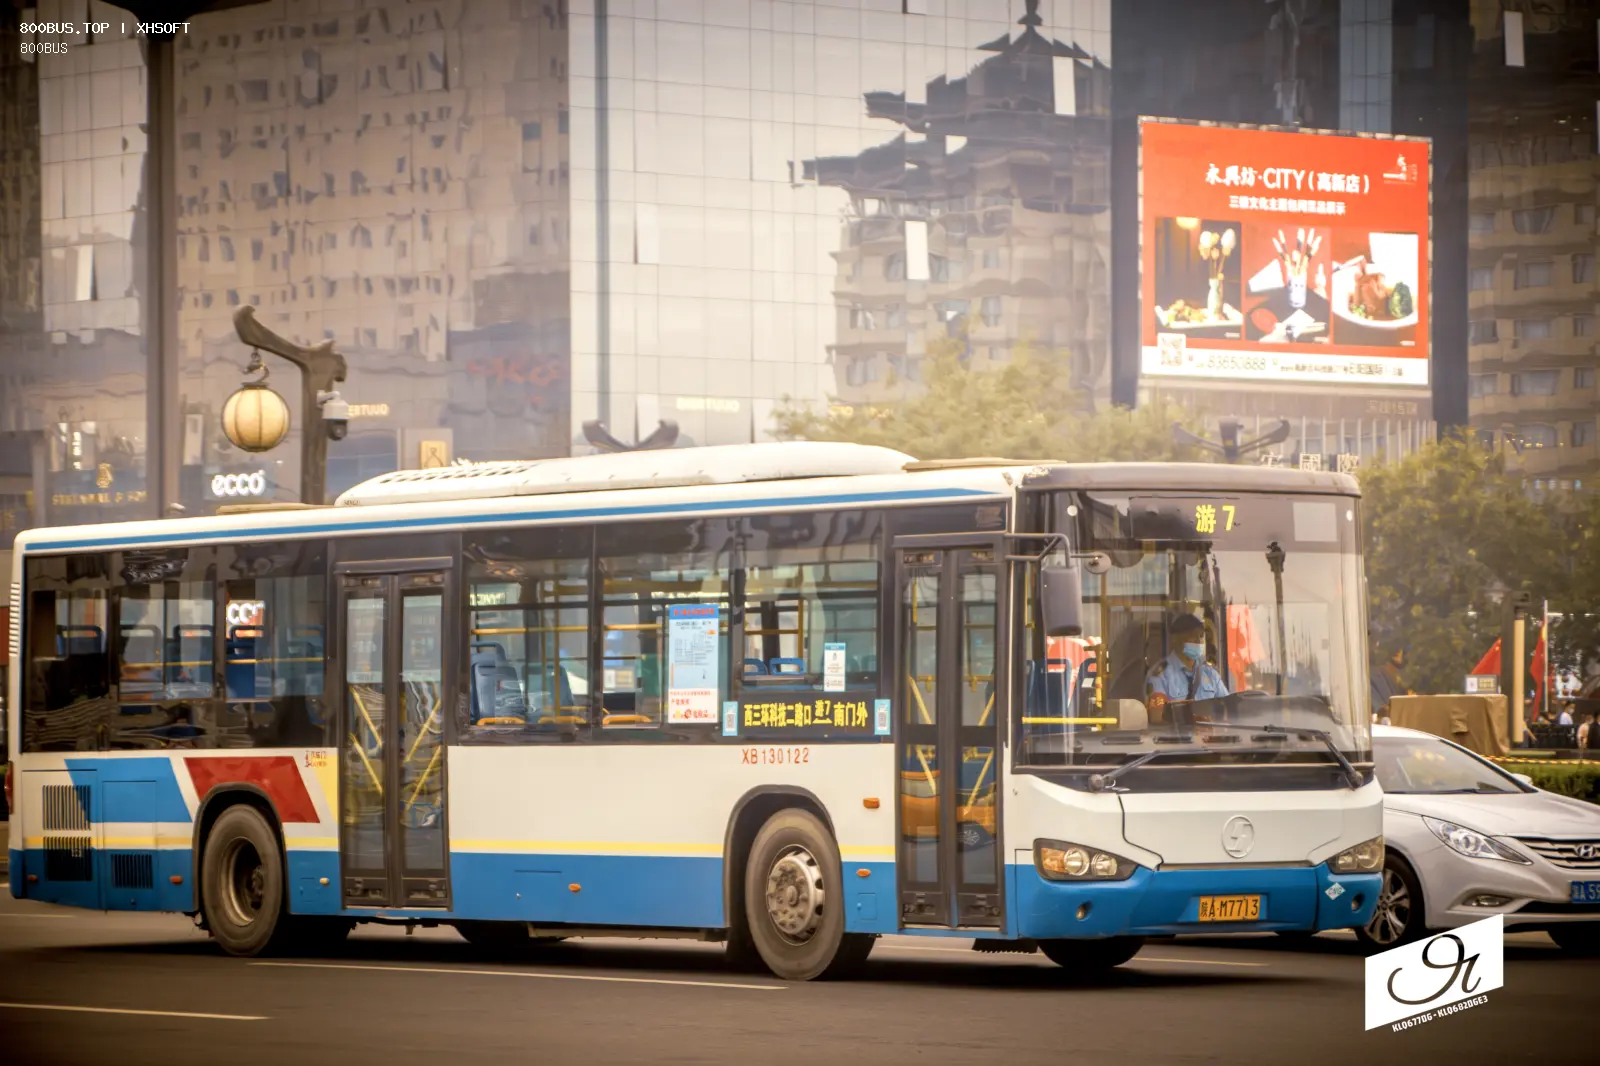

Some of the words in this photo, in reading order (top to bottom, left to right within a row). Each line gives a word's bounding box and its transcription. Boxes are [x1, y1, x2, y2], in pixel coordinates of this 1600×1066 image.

[211, 472, 265, 497] ecco
[743, 702, 812, 727] 西三环科技二路口
[833, 701, 868, 728] 南门外
[742, 747, 810, 765] XB130122
